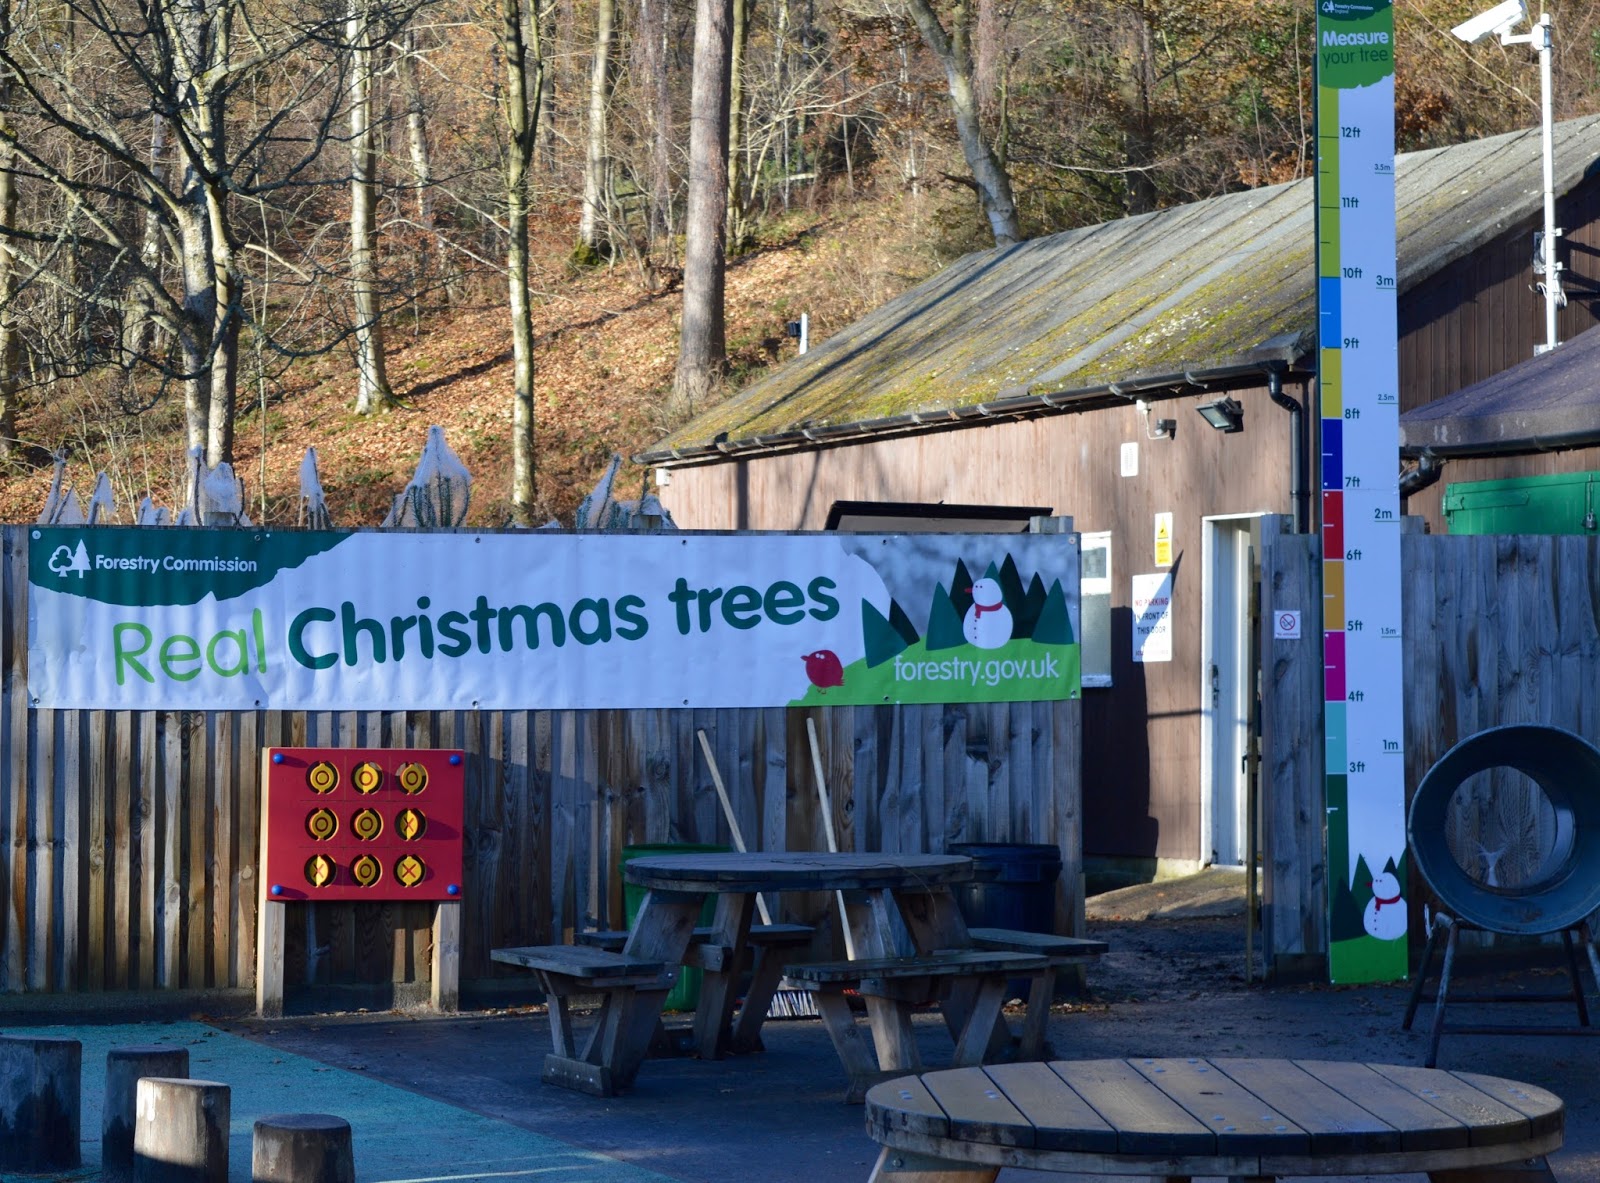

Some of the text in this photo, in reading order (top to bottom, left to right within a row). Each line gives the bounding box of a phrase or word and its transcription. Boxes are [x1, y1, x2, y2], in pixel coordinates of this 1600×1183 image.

[1322, 30, 1389, 47] Measure
[1322, 47, 1389, 69] your tree
[1341, 126, 1361, 138] 12ft
[1374, 163, 1391, 171] 3.5m
[1341, 196, 1360, 208] 11ft
[1342, 267, 1363, 279] 10ft
[1375, 275, 1394, 286] 3m
[1343, 337, 1360, 349] 9ft
[1377, 393, 1395, 401] 2.5m
[1344, 408, 1361, 420] 8ft
[1344, 476, 1361, 488] 7ft
[1374, 508, 1392, 519] 2m
[1346, 549, 1362, 561] 6ft
[95, 554, 258, 575] Forestry Commission
[1144, 597, 1169, 606] PARKING
[1142, 612, 1159, 620] FRONT
[112, 575, 841, 686] Real Christmas trees
[1137, 627, 1150, 635] THIS
[1347, 620, 1363, 632] 5ft
[1381, 627, 1396, 635] 1.5m
[893, 652, 1060, 688] forestry.gov.uk
[1348, 690, 1364, 702] 4ft
[1382, 739, 1399, 750] 1m
[1349, 761, 1365, 773] 3ft
